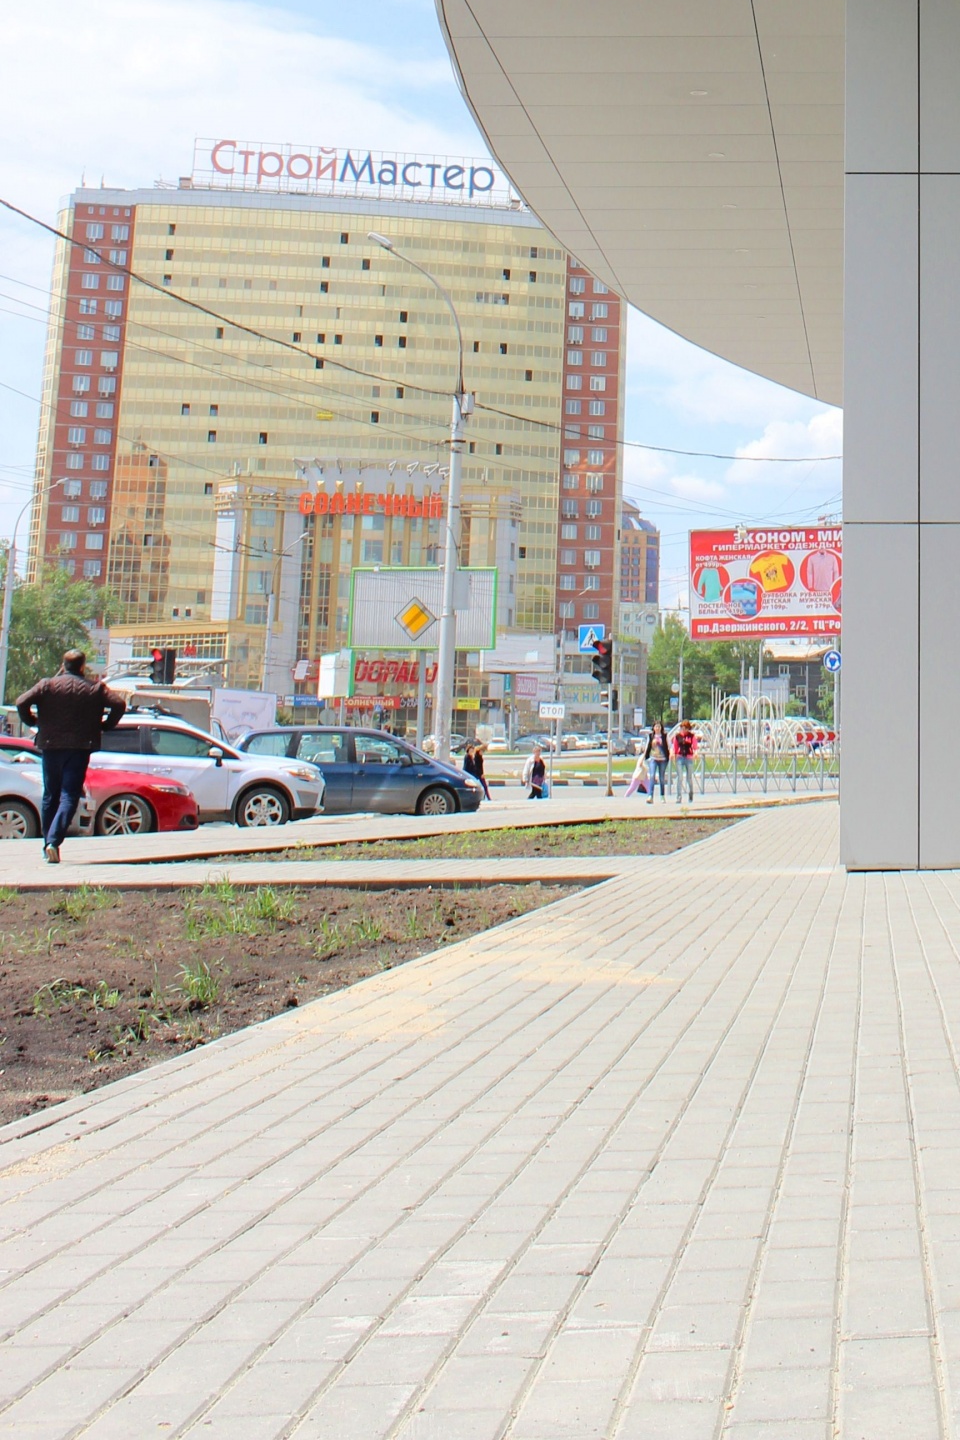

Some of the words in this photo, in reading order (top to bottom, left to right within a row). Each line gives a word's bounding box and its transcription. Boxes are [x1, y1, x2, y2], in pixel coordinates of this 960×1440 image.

[211, 139, 495, 198] СтройМастер
[299, 491, 443, 518] СОЛНЕЧНЫЙ
[733, 531, 805, 544] ЭКОНОМ
[712, 543, 788, 552] ГИПЕРМАРКЕТ
[788, 542, 836, 551] ОДЕЖДЫ
[541, 706, 563, 715] СТОП
